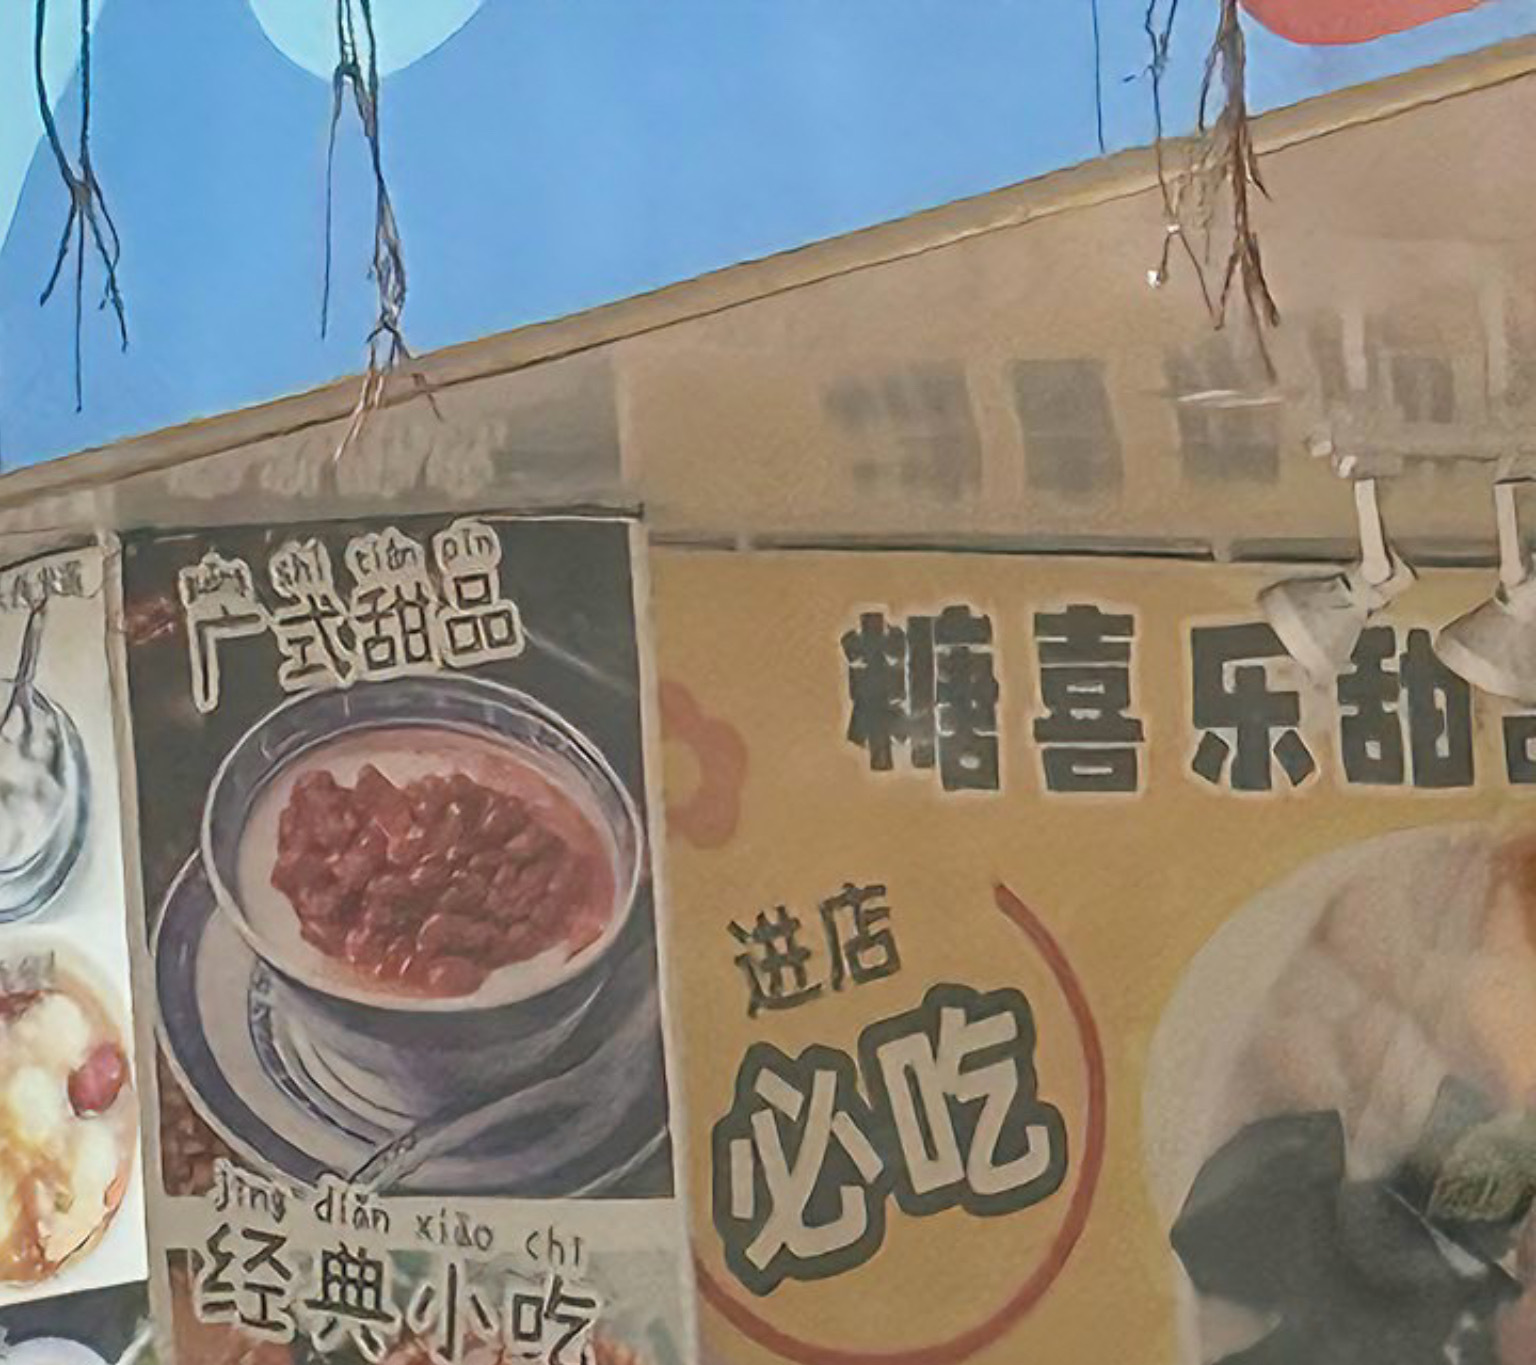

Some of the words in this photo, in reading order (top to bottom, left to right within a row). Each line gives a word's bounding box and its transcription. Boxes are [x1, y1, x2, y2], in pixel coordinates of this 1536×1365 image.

[194, 571, 514, 706] 广式甜品
[840, 604, 1536, 792] 糖喜乐甜
[728, 882, 902, 1018] 进店
[714, 986, 1065, 1294] 必吃
